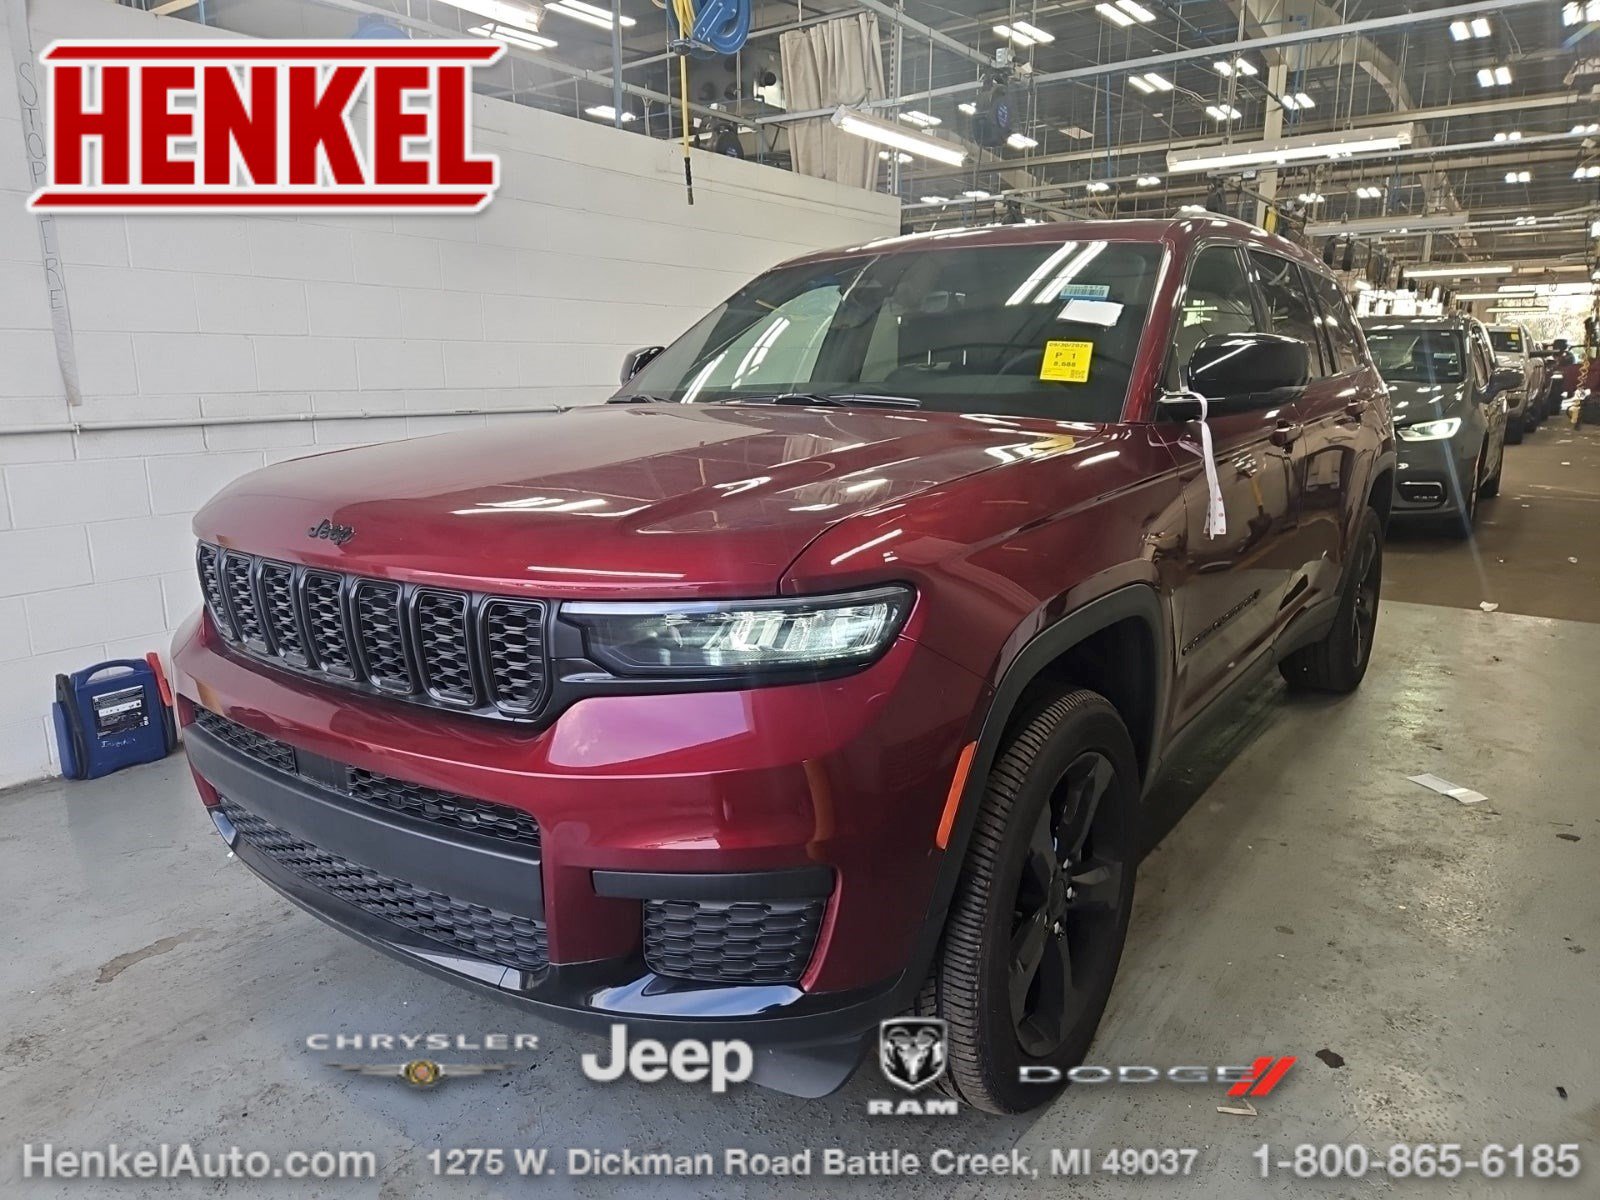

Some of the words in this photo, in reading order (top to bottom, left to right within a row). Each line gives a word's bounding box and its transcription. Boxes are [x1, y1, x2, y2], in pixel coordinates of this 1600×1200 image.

[20, 62, 47, 184] STOP
[40, 219, 64, 310] ERE
[308, 518, 355, 546] Jeep
